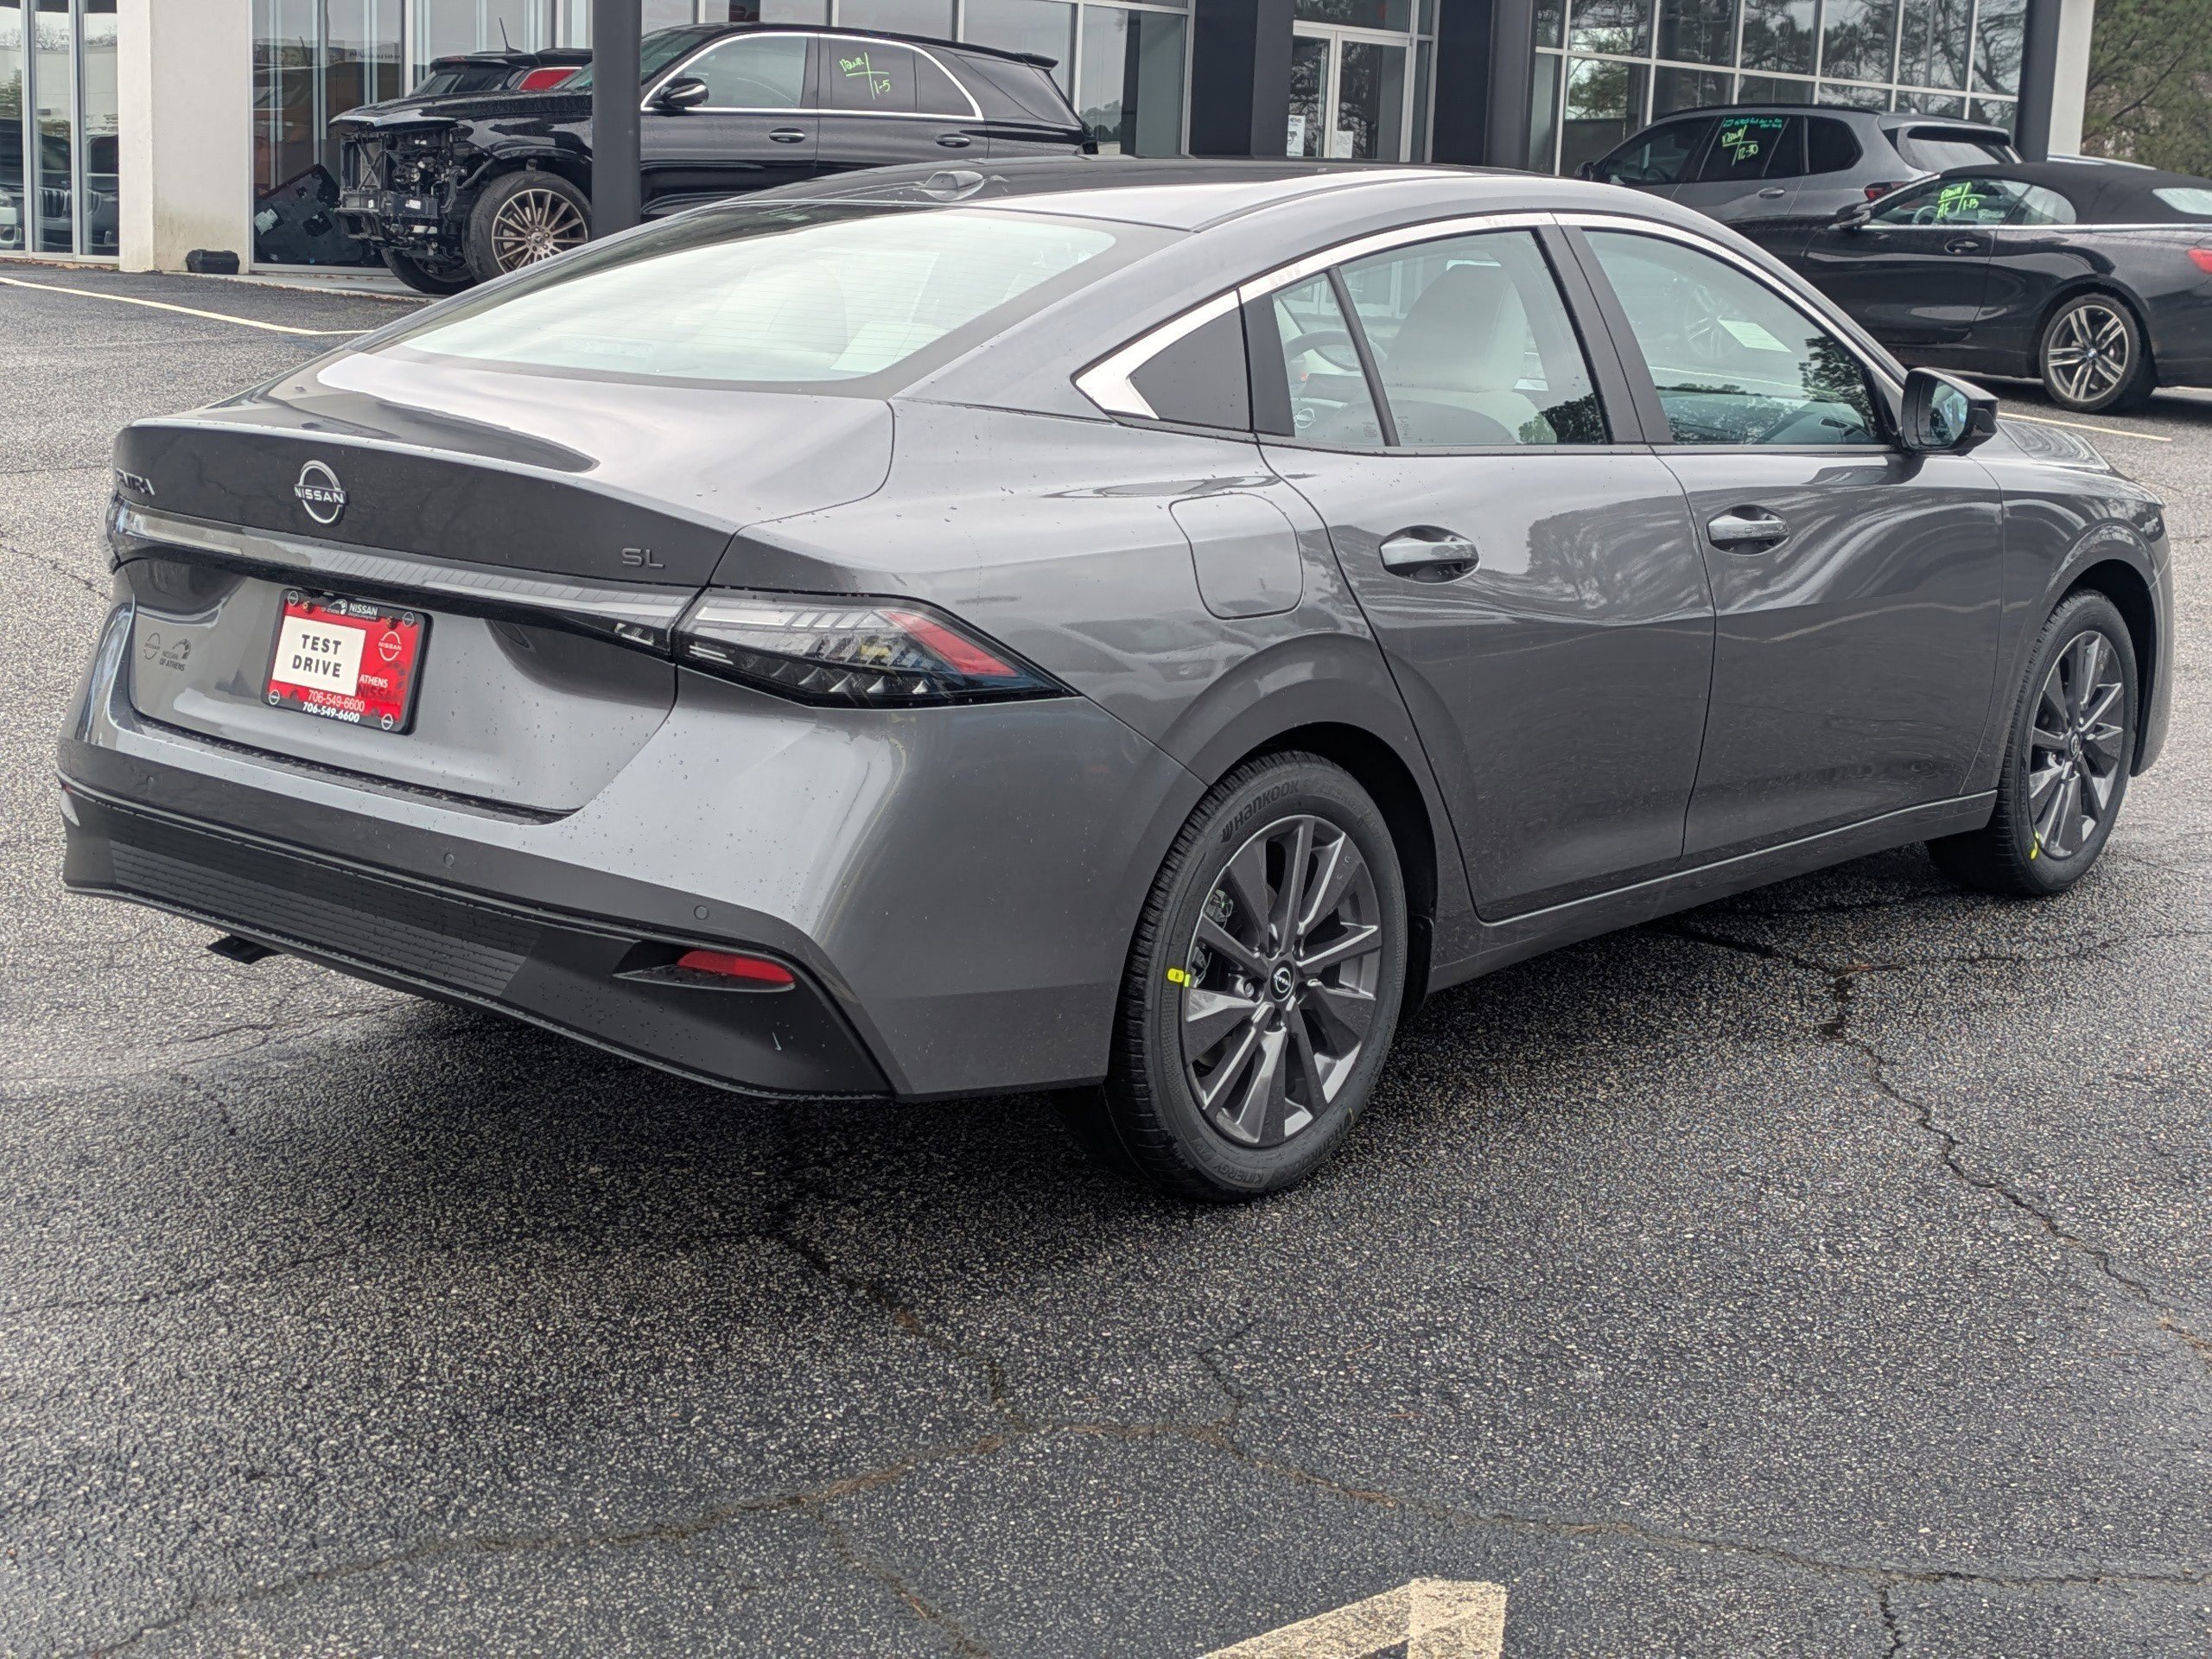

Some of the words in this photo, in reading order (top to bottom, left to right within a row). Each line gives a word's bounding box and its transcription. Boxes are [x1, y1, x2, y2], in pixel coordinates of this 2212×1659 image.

[294, 485, 345, 505] NISSAN
[622, 548, 664, 569] SL
[349, 602, 378, 616] NISSAN
[302, 633, 342, 655] TEST
[378, 641, 402, 652] NISSAN
[292, 654, 342, 678] DRIVE
[359, 673, 389, 688] ATHENS
[308, 689, 365, 712] 706-549-6600
[302, 702, 360, 723] 706-549-6600
